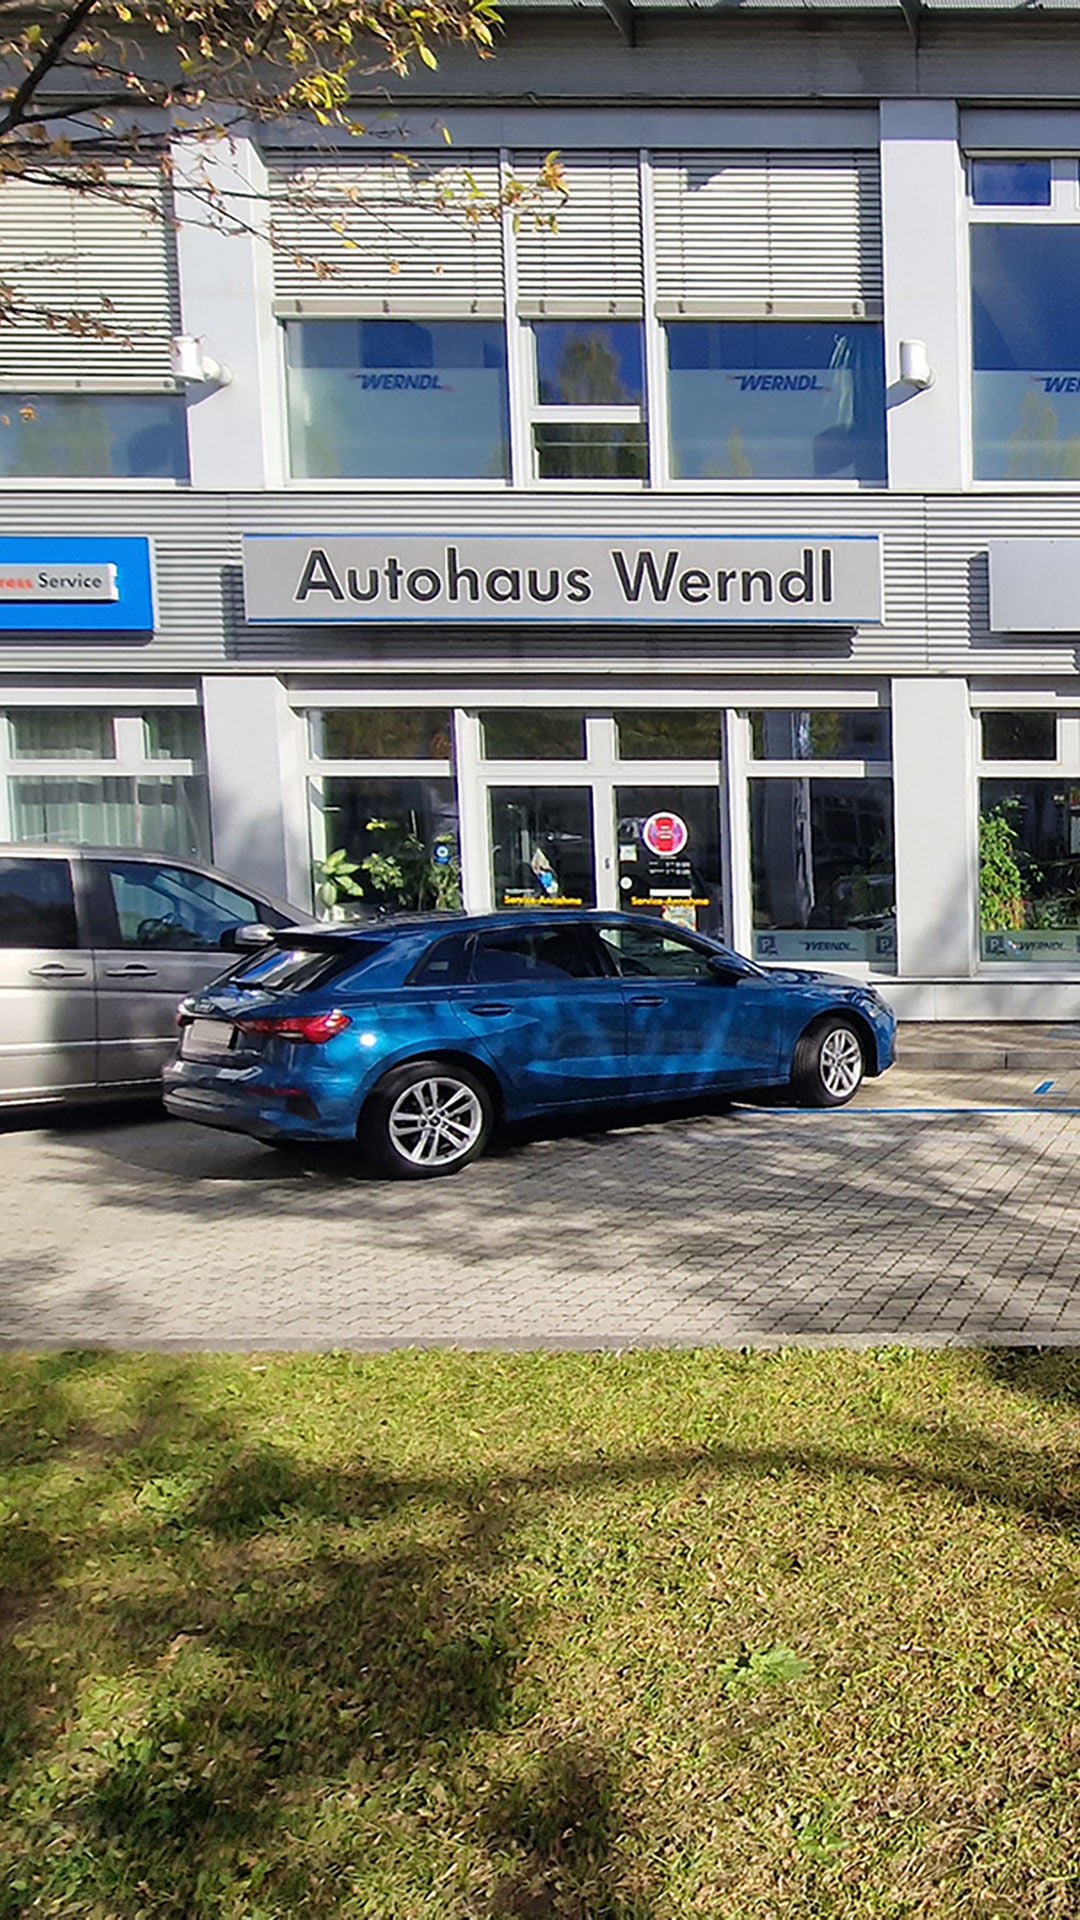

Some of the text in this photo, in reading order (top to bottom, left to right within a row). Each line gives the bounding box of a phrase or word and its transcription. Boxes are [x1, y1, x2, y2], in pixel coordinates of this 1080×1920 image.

[356, 373, 443, 391] WERNDL
[734, 374, 823, 391] WERNDL
[1039, 376, 1080, 393] WE
[38, 572, 103, 588] Service
[295, 546, 833, 602] Autohaus Werndl
[799, 941, 858, 952] WERNDL
